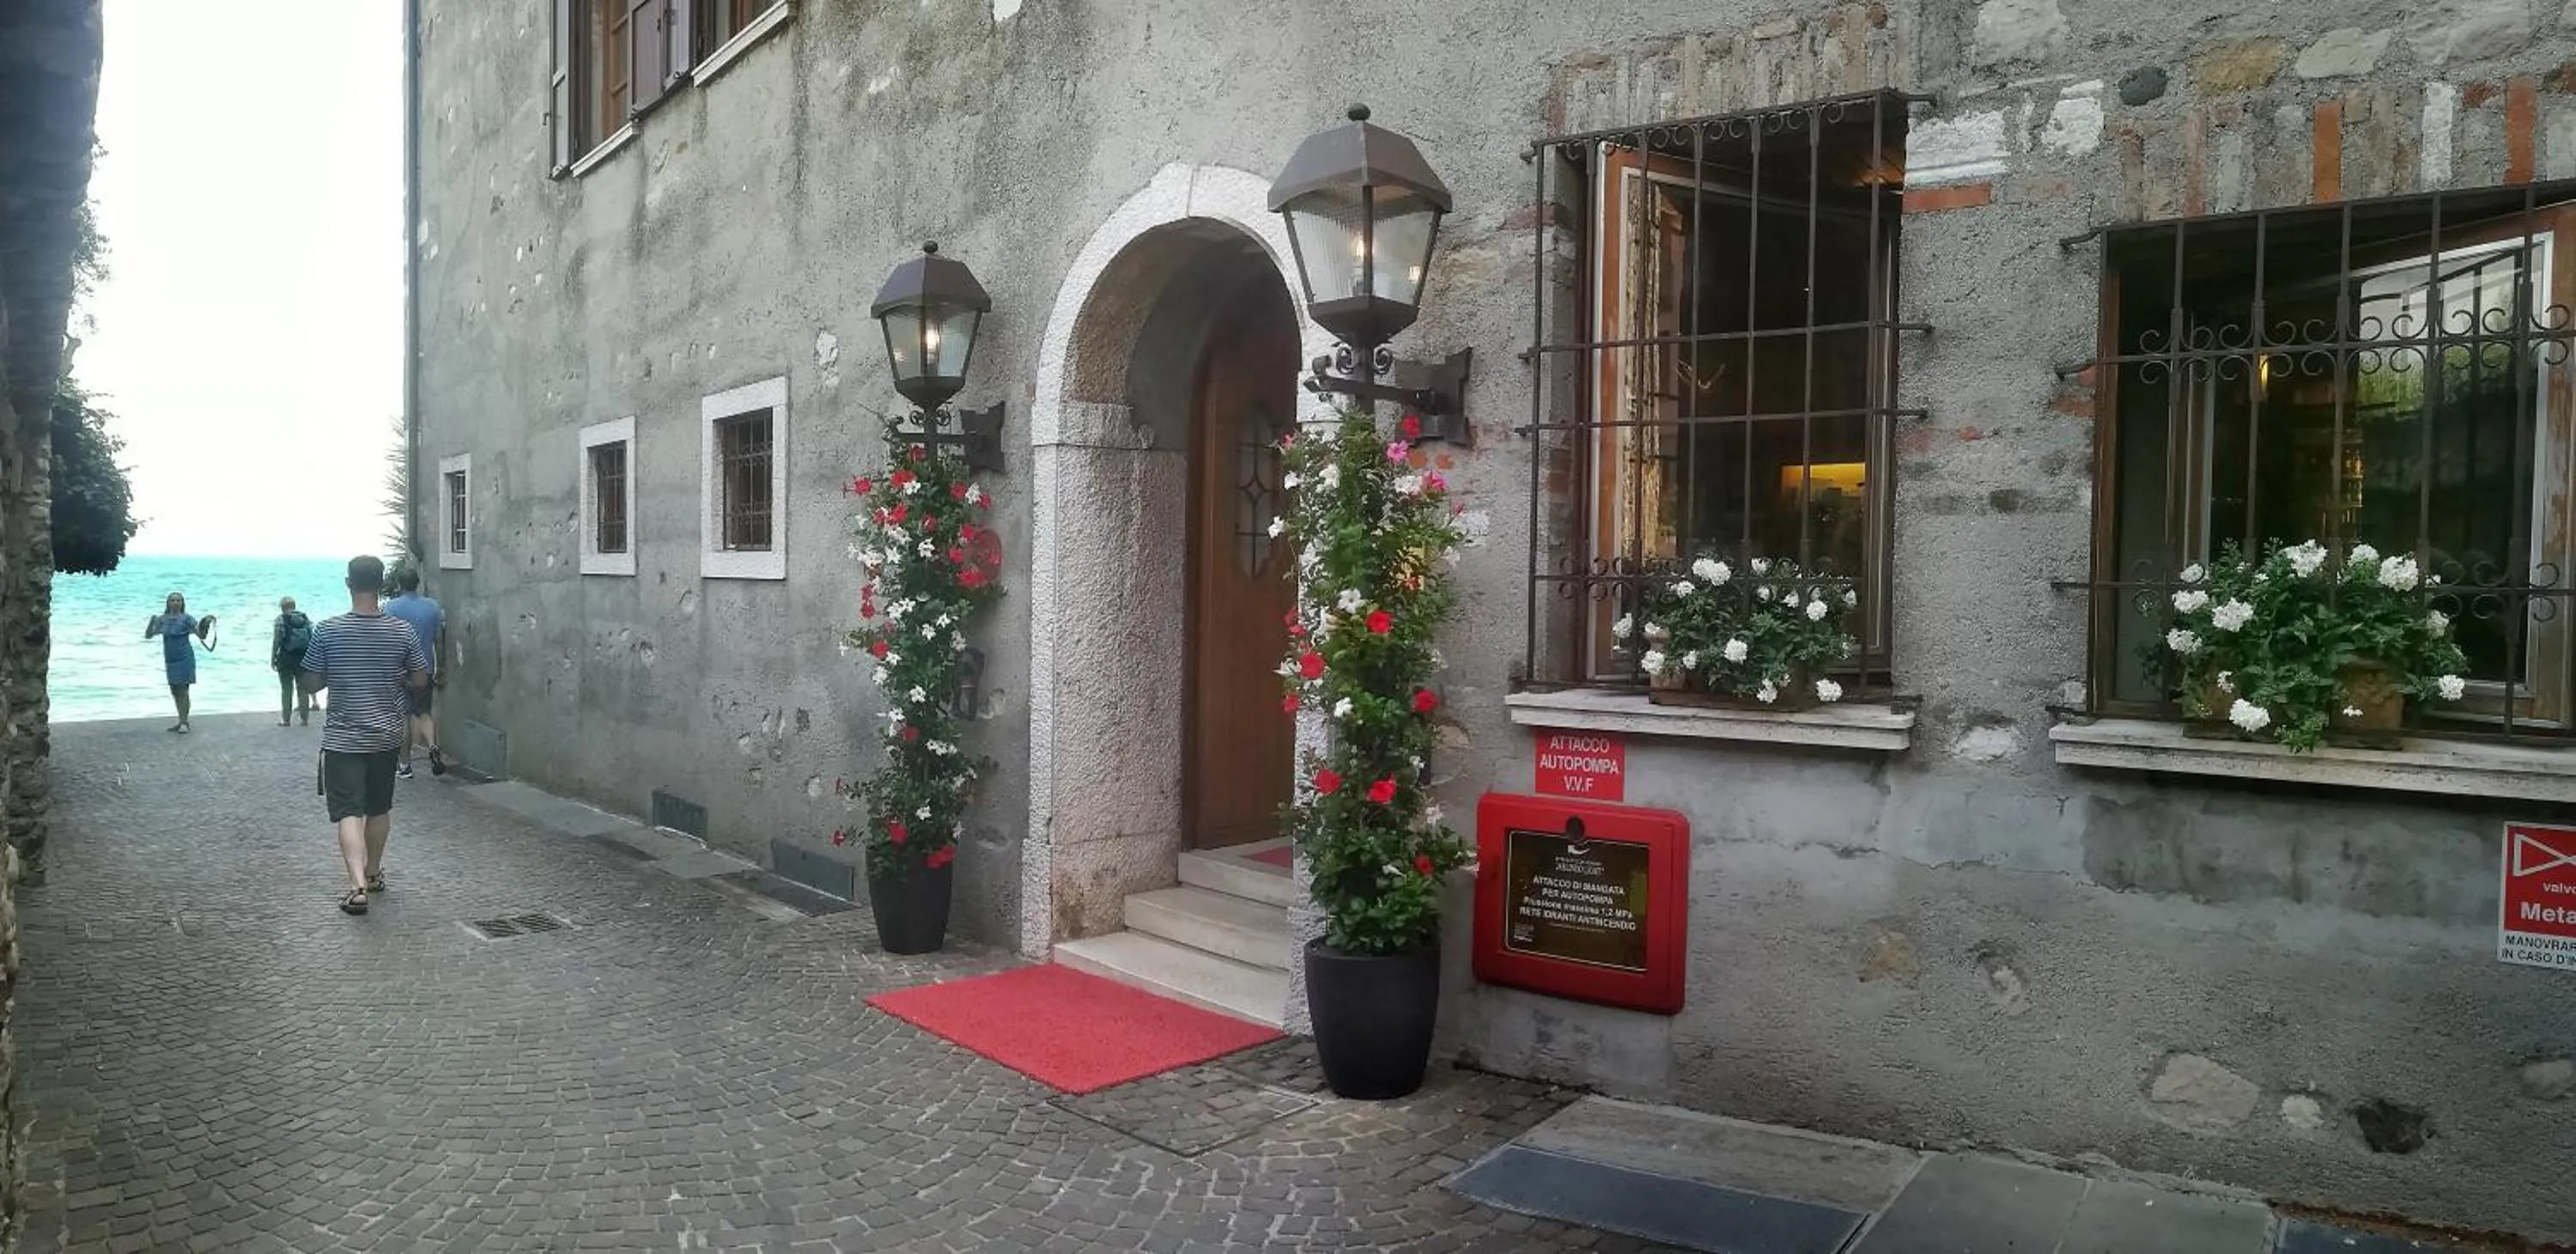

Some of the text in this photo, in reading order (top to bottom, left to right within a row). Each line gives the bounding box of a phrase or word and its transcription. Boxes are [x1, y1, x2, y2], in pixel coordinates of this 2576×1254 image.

[1550, 735, 1610, 753] ATTACCO
[1540, 754, 1619, 775] AUTOPOMPA
[1533, 875, 1625, 895] ATTACCO DI MANDATA
[1541, 887, 1613, 904] PER AUTOPOMPA
[1519, 906, 1541, 916] RETE
[1543, 910, 1577, 922] IDRANTI
[1577, 915, 1636, 930] ANTINCENDIO
[2501, 947, 2513, 959] IN
[2517, 950, 2553, 963] CASO
